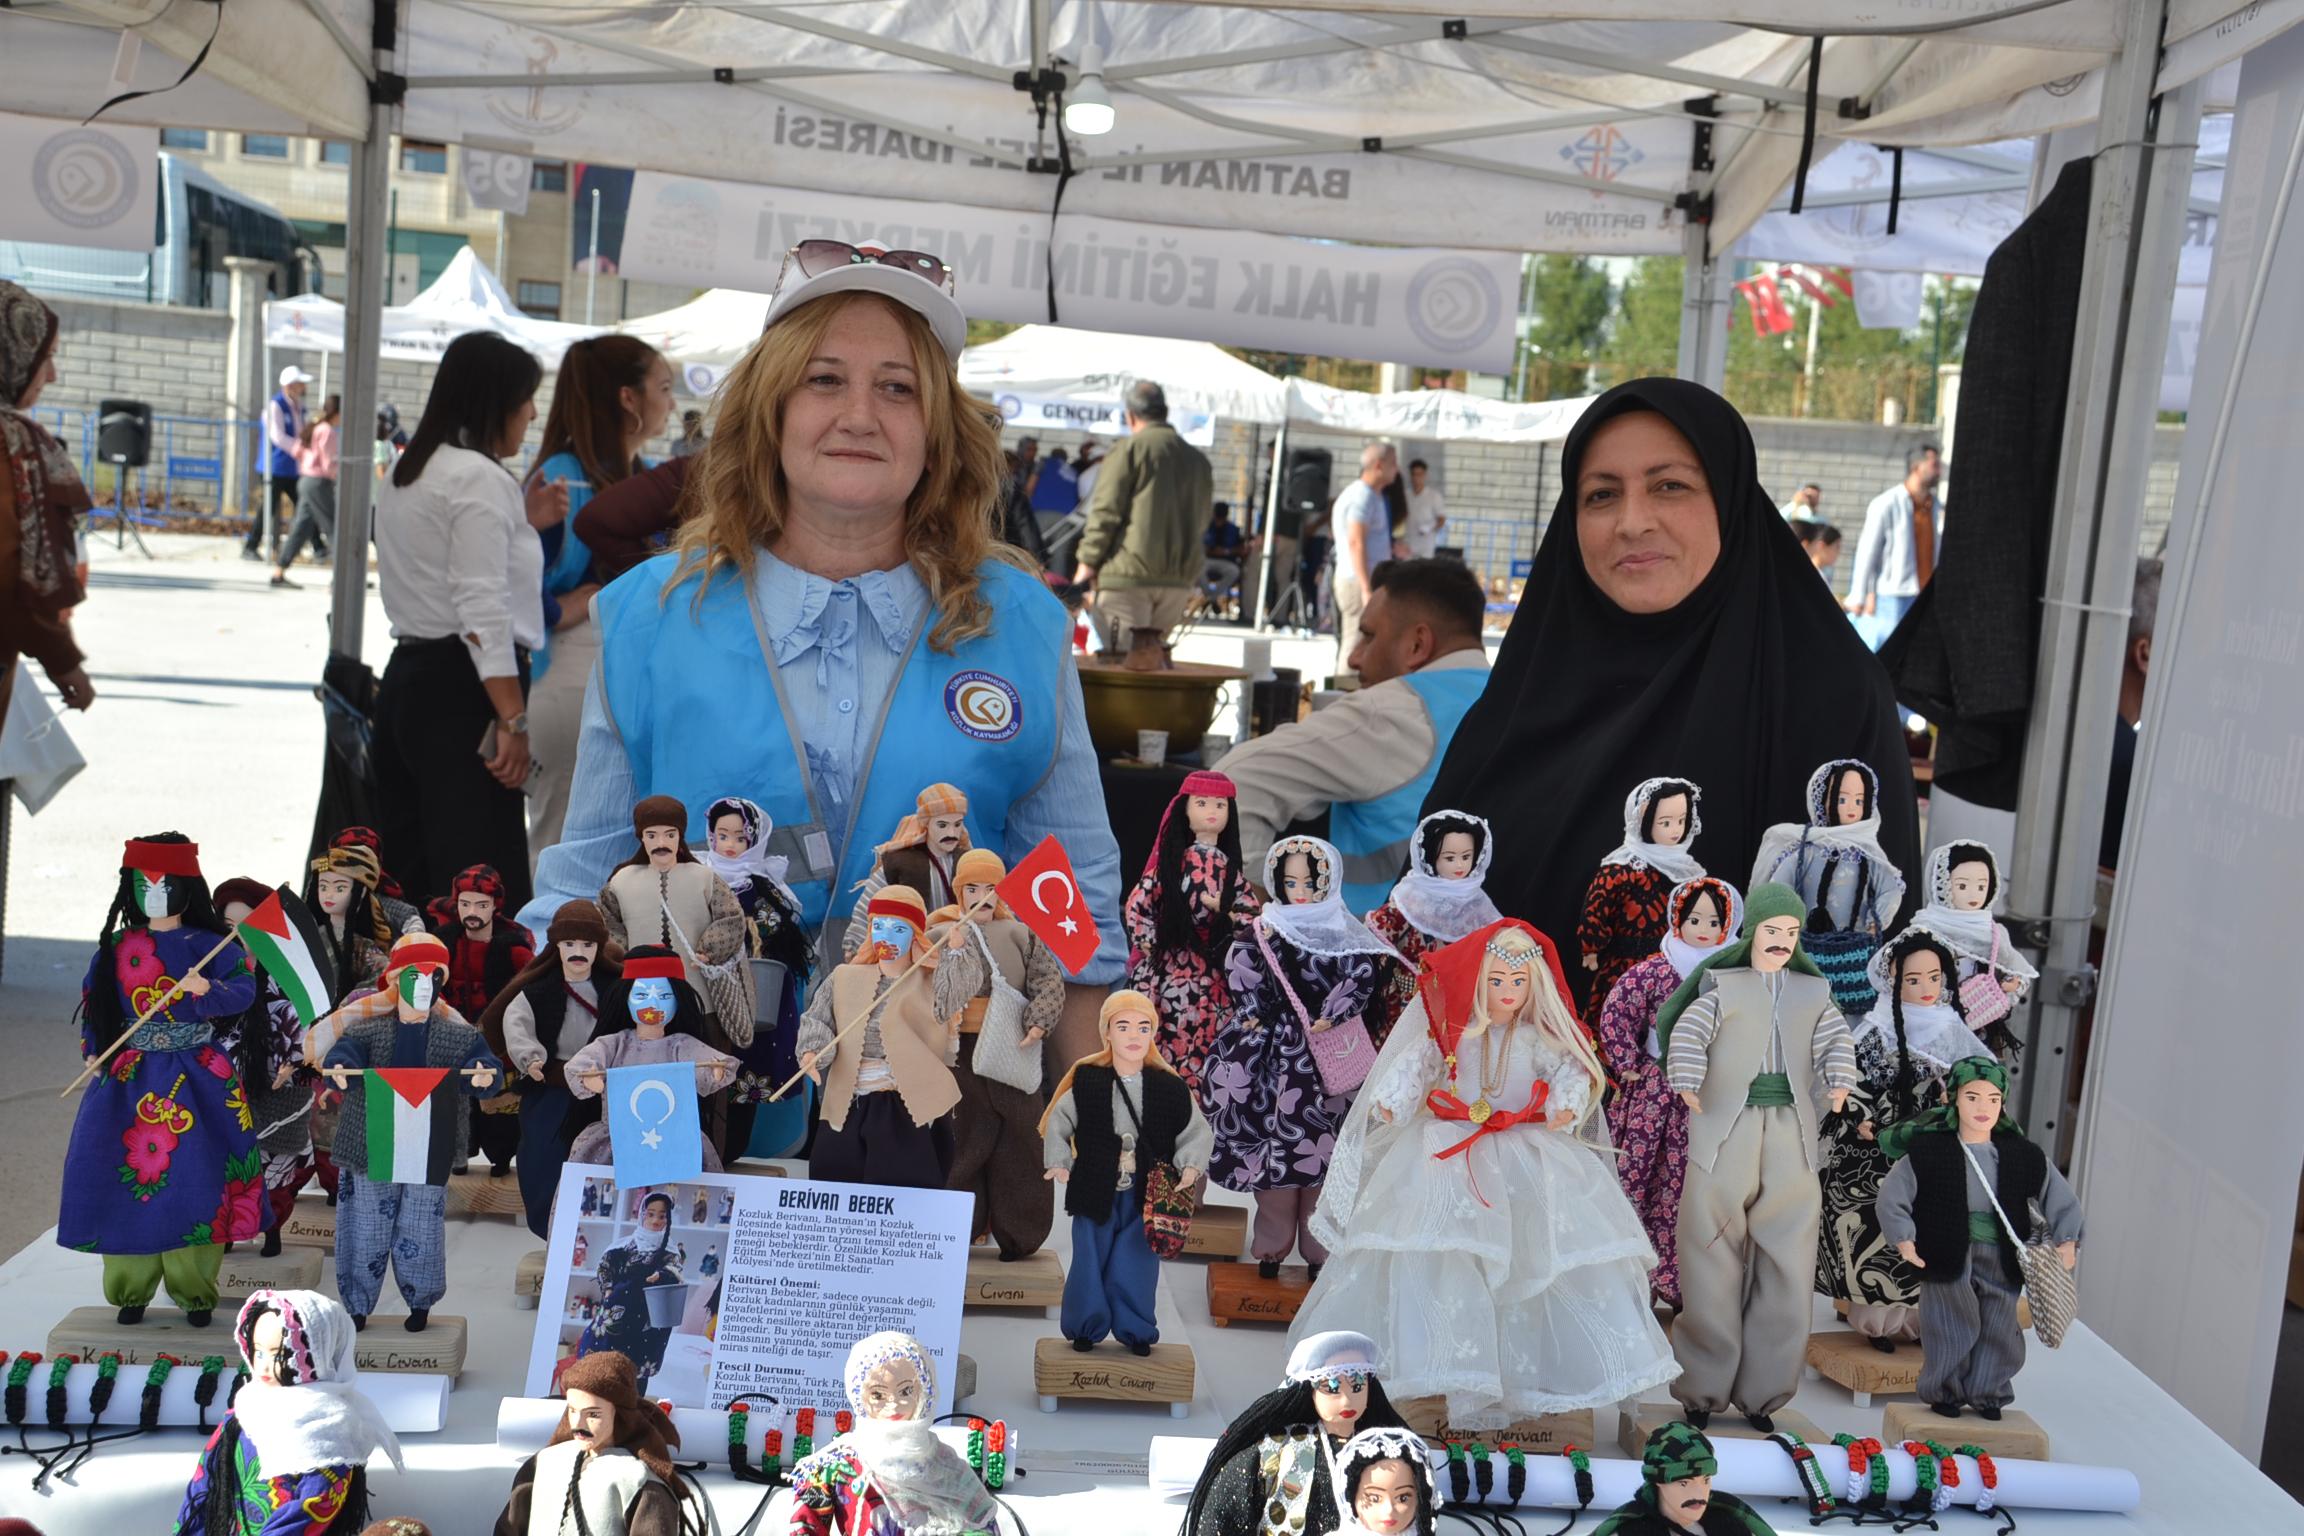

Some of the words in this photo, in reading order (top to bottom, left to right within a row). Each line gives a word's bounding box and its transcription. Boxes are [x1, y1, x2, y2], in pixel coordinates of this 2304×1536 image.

[848, 1195, 895, 1215] BEBEK
[738, 1209, 772, 1218] Kozluk
[775, 1211, 820, 1223] Berivanı,
[880, 1219, 914, 1229] Kozluk
[735, 1227, 789, 1241] geleneksel
[792, 1233, 825, 1244] yaşam
[828, 1234, 861, 1244] tarzını
[864, 1237, 895, 1246] temsil
[898, 1239, 923, 1248] eden
[926, 1241, 935, 1249] el
[737, 1218, 782, 1230] ilçesinde
[785, 1221, 836, 1232] kadınların
[839, 1225, 876, 1238] yöresel
[879, 1228, 941, 1242] kıyafetlerini
[733, 1237, 765, 1249] emeği
[768, 1239, 830, 1251] bebeklerdir.
[833, 1242, 878, 1254] Özellikle
[881, 1247, 916, 1257] Kozluk
[919, 1250, 943, 1259] Halk
[733, 1246, 766, 1258] Eğitim
[834, 1253, 844, 1261] El
[847, 1254, 894, 1265] Sanatları
[797, 1260, 874, 1273] üretilmektedir.
[729, 1274, 776, 1285] Kültürel
[780, 1276, 821, 1288] Önemi:
[727, 1284, 767, 1294] Berivan
[770, 1287, 820, 1300] Bebekler,
[823, 1291, 858, 1301] sadece
[861, 1294, 904, 1306] oyuncak
[906, 1297, 935, 1308] değil;
[726, 1294, 761, 1304] Kozluk
[764, 1297, 826, 1308] kadınlarının
[829, 1301, 864, 1313] günlük
[867, 1306, 916, 1317] yaşamını,
[723, 1313, 757, 1325] gelecek
[761, 1316, 811, 1327] nesillere
[813, 1319, 854, 1329] aktaran
[857, 1322, 872, 1331] bir
[724, 1304, 787, 1317] kıyafetlerini
[805, 1309, 846, 1319] kültürel
[848, 1312, 905, 1326] değerlerini
[721, 1323, 771, 1336] simgedir.
[774, 1326, 788, 1335] Bu
[790, 1328, 831, 1340] yönüyle
[720, 1333, 770, 1344] olmasının
[773, 1336, 817, 1349] yanında,
[719, 1342, 748, 1352] miras
[751, 1344, 788, 1357] niteliği
[791, 1347, 804, 1355] de
[806, 1349, 833, 1360] taşır.
[717, 1361, 750, 1371] Tescil
[755, 1364, 805, 1375] Durumu:
[715, 1371, 751, 1381] Kozluk
[754, 1374, 798, 1386] Berivanı,
[803, 1376, 829, 1386] Türk
[1069, 1371, 1113, 1390] Kozluk
[714, 1381, 756, 1391] Kurumu
[759, 1384, 813, 1395] tarafından
[782, 1396, 819, 1405] biridir.
